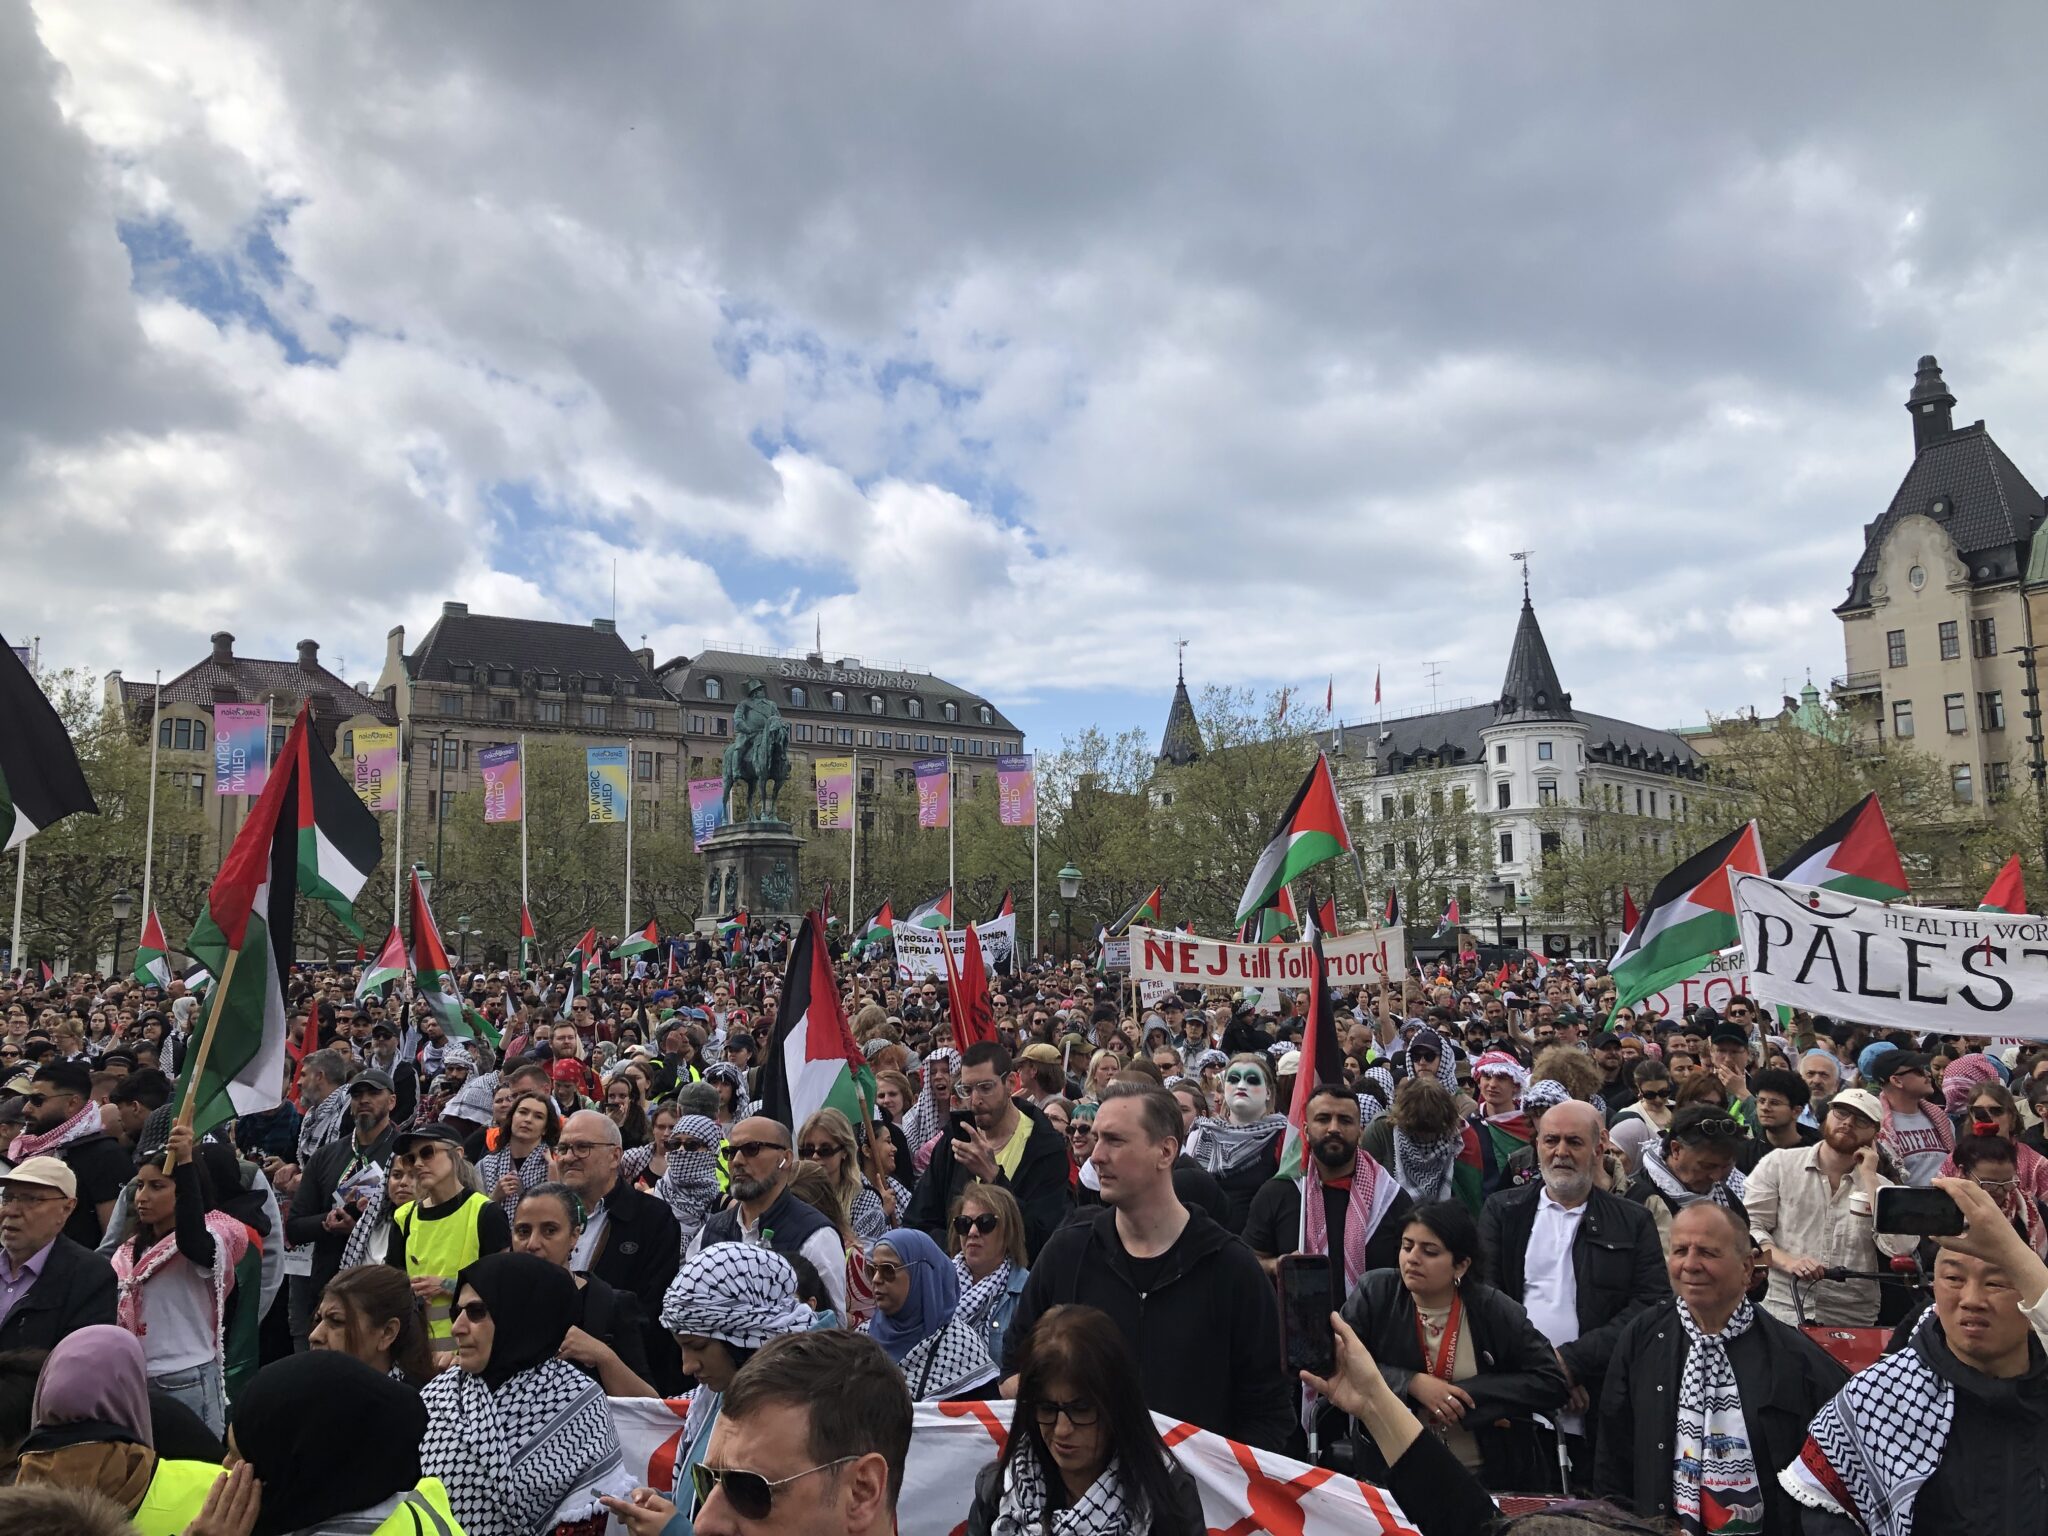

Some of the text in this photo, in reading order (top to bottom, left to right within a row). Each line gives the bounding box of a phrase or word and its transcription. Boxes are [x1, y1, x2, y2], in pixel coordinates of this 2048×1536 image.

[1884, 913, 1980, 939] HEALTH
[897, 932, 934, 943] KROSSA
[898, 945, 988, 955] BEFRIA PAESA
[1144, 939, 1228, 976] NEJ
[1238, 946, 1271, 979] till
[1147, 980, 1164, 990] FREE
